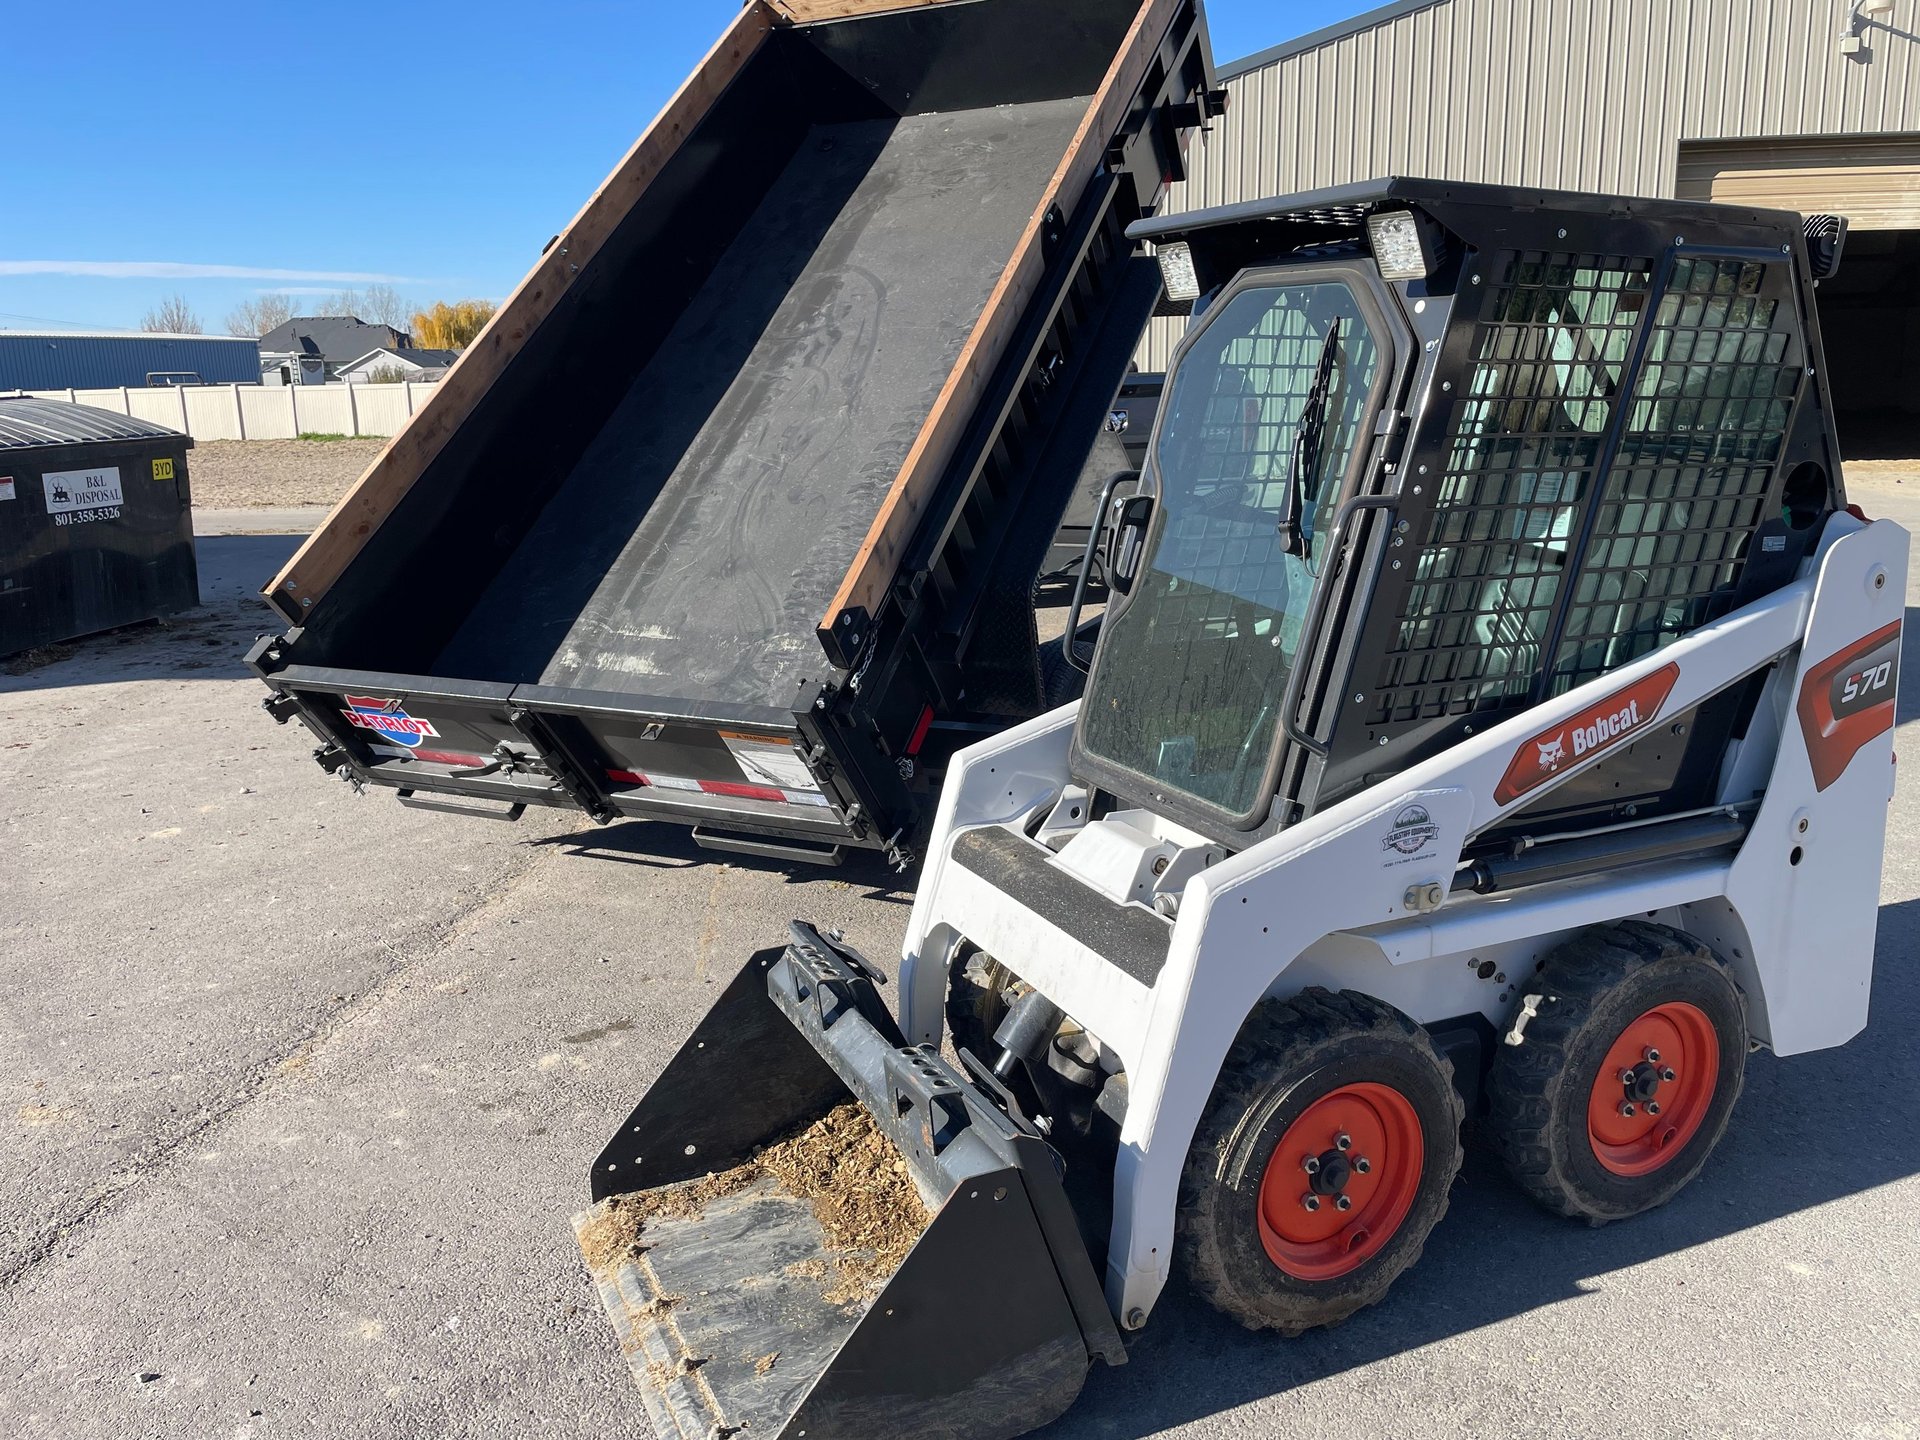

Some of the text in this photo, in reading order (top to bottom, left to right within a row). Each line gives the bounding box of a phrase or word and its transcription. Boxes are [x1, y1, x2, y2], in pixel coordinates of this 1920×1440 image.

[154, 462, 172, 476] 3YD
[86, 475, 108, 488] B&L
[75, 488, 121, 505] DISPOSAL
[55, 507, 120, 527] 801-358-5326
[1841, 661, 1892, 704] S70
[343, 710, 434, 736] PATRIOT
[1572, 700, 1638, 757] Bobcat
[1389, 829, 1411, 842] FLAGSTAFF
[1411, 826, 1434, 837] EQUIPMENT
